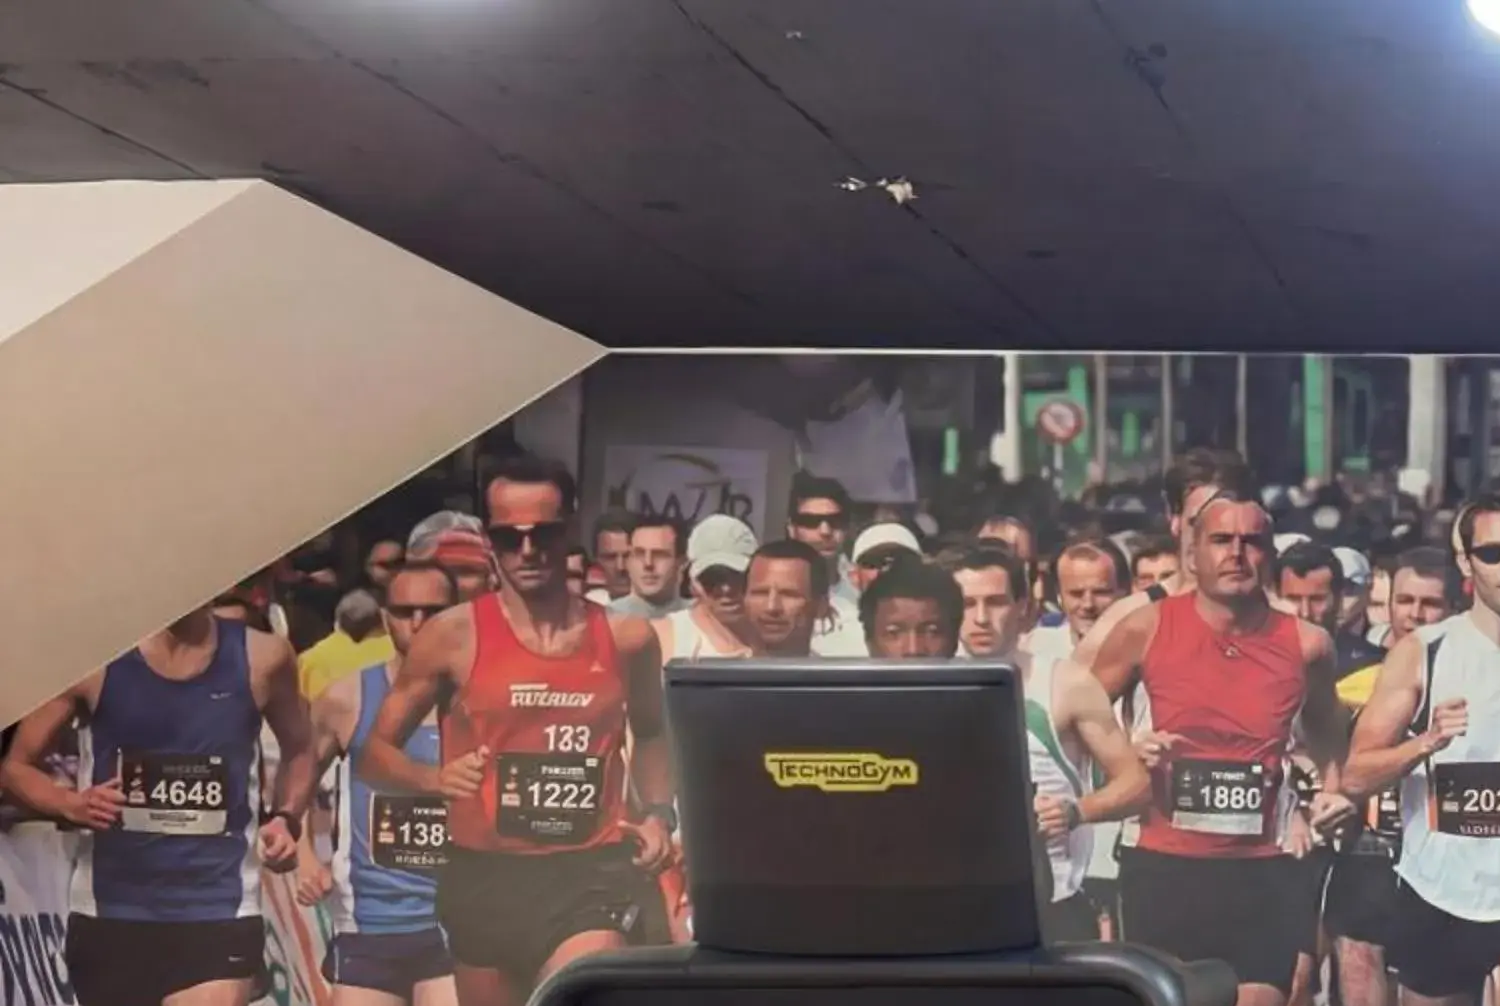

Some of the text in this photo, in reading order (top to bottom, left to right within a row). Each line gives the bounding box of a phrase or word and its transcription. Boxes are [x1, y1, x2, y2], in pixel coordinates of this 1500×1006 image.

[150, 779, 223, 806] 4648
[528, 781, 597, 809] 1222
[1200, 785, 1262, 810] 1880
[399, 821, 452, 847] 138
